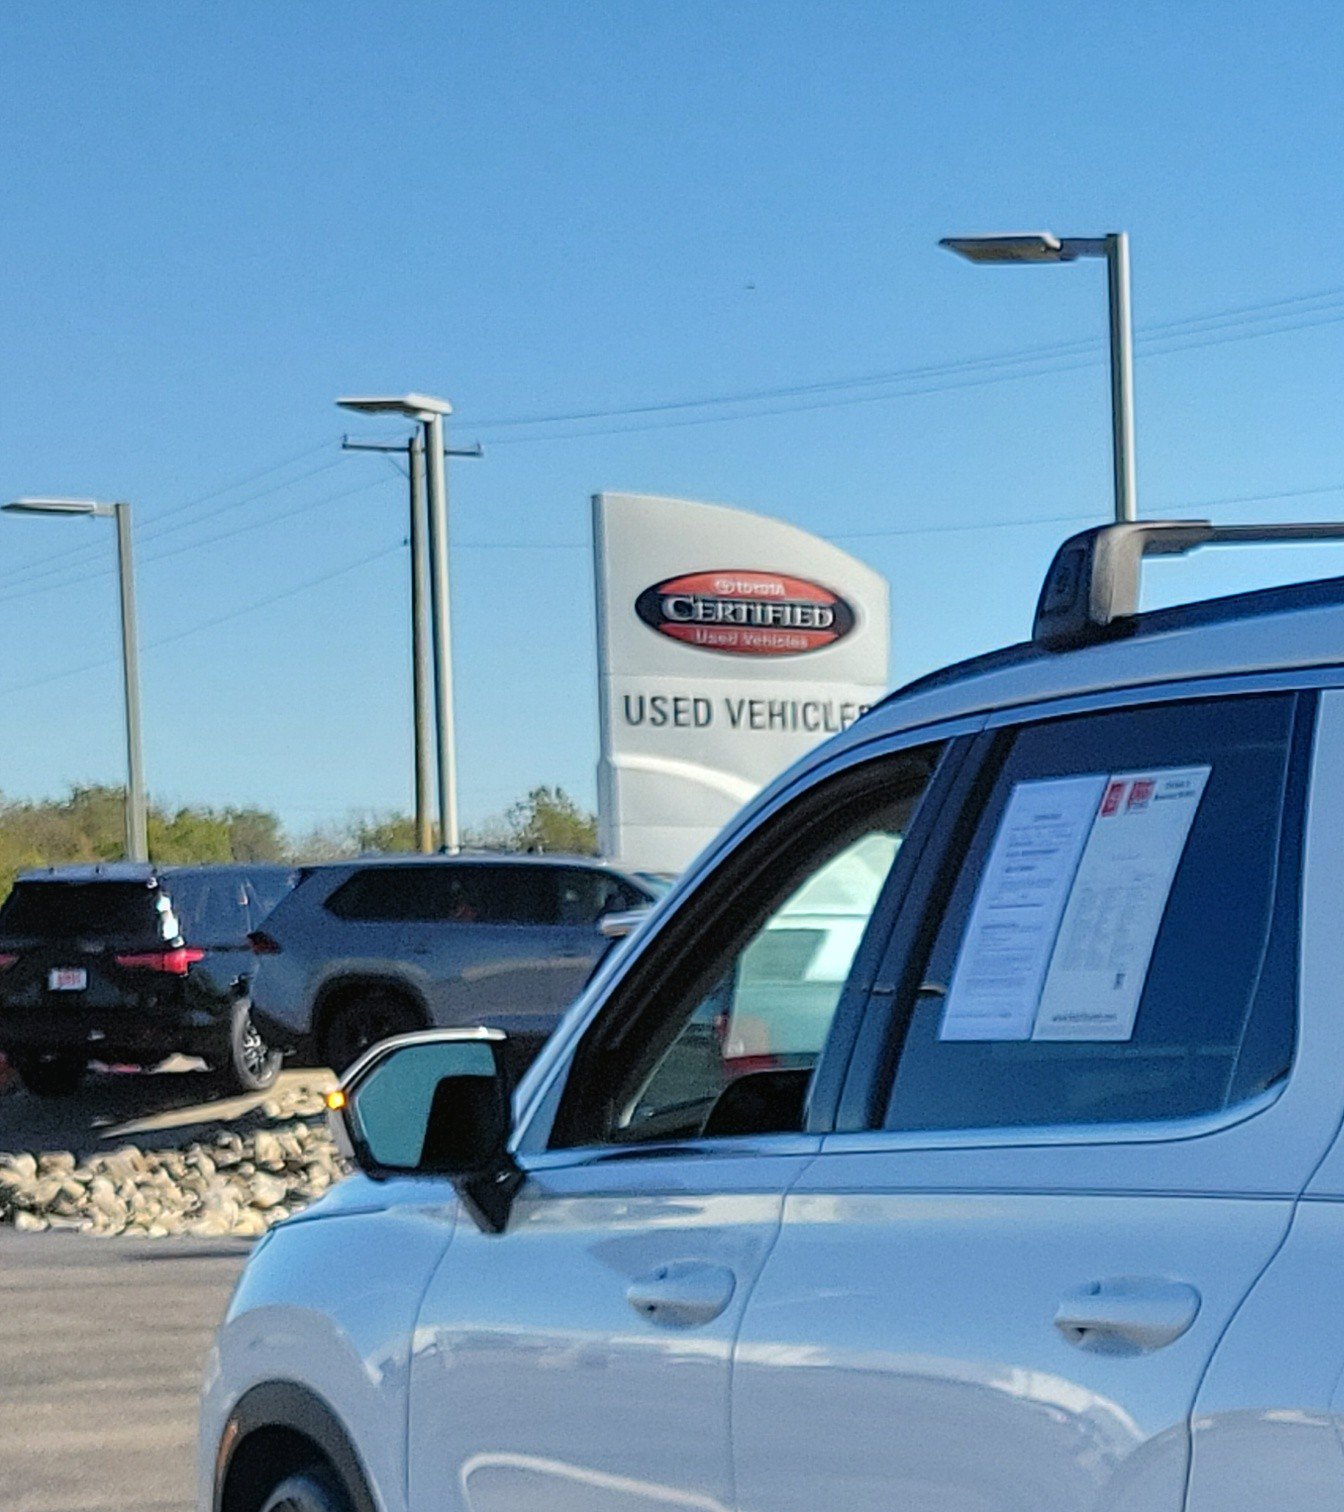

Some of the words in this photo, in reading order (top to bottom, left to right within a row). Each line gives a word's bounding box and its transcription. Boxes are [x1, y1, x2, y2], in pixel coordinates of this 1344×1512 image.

[660, 597, 834, 628] CERTIFIED
[696, 629, 738, 645] Used
[743, 634, 808, 649] Vehicles
[623, 695, 712, 727] USED
